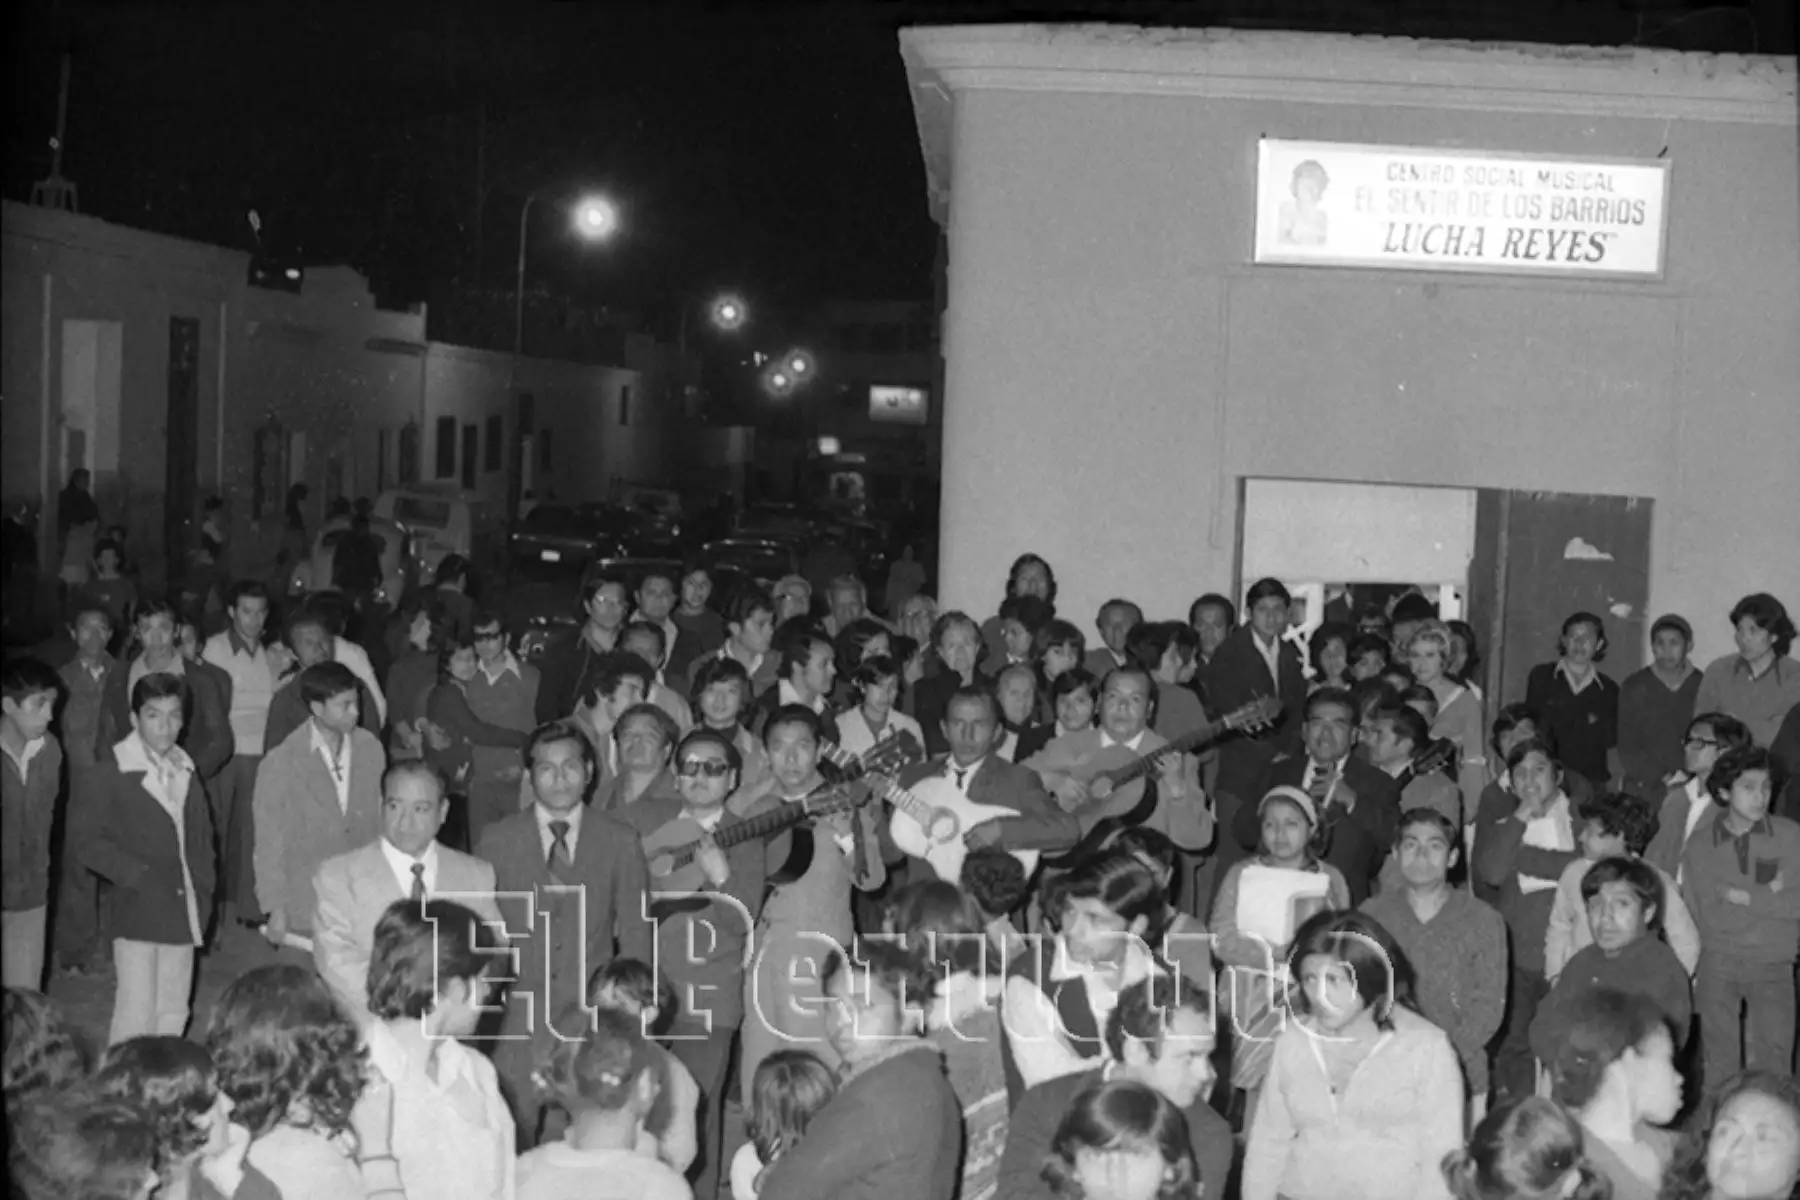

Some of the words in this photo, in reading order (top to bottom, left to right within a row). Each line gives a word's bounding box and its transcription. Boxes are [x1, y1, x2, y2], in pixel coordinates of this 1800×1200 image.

[1386, 161, 1455, 185] CENTRO
[1463, 165, 1524, 188] SOCIAL
[1537, 168, 1616, 193] MUSICAL
[1354, 186, 1378, 214] EL
[1386, 187, 1460, 217] SENTIR
[1468, 191, 1496, 218] DE
[1502, 193, 1543, 221] LOS
[1550, 195, 1647, 226] BARRIOS
[1382, 221, 1486, 257] LUCHA
